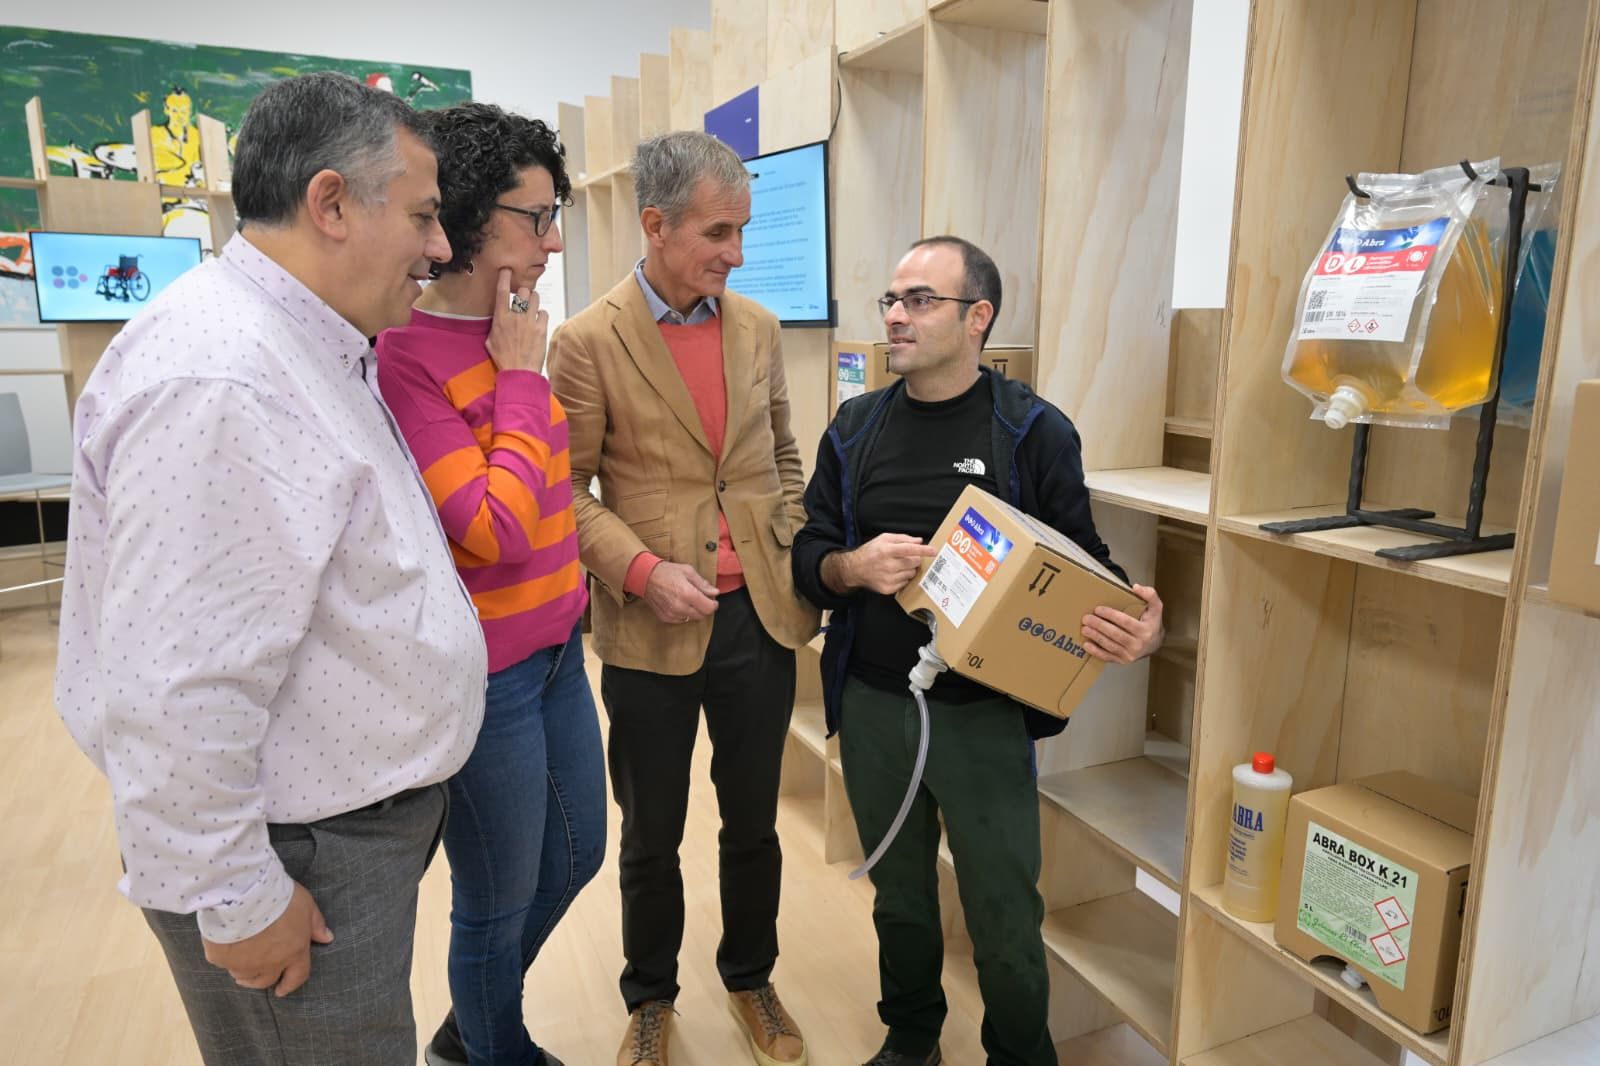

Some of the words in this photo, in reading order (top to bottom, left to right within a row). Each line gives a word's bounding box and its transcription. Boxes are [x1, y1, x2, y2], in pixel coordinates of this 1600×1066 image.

[1232, 801, 1263, 832] ABRA
[1313, 832, 1344, 858] ABRA
[1349, 849, 1375, 872] BOX
[1379, 864, 1388, 879] K
[1392, 871, 1407, 888] 21
